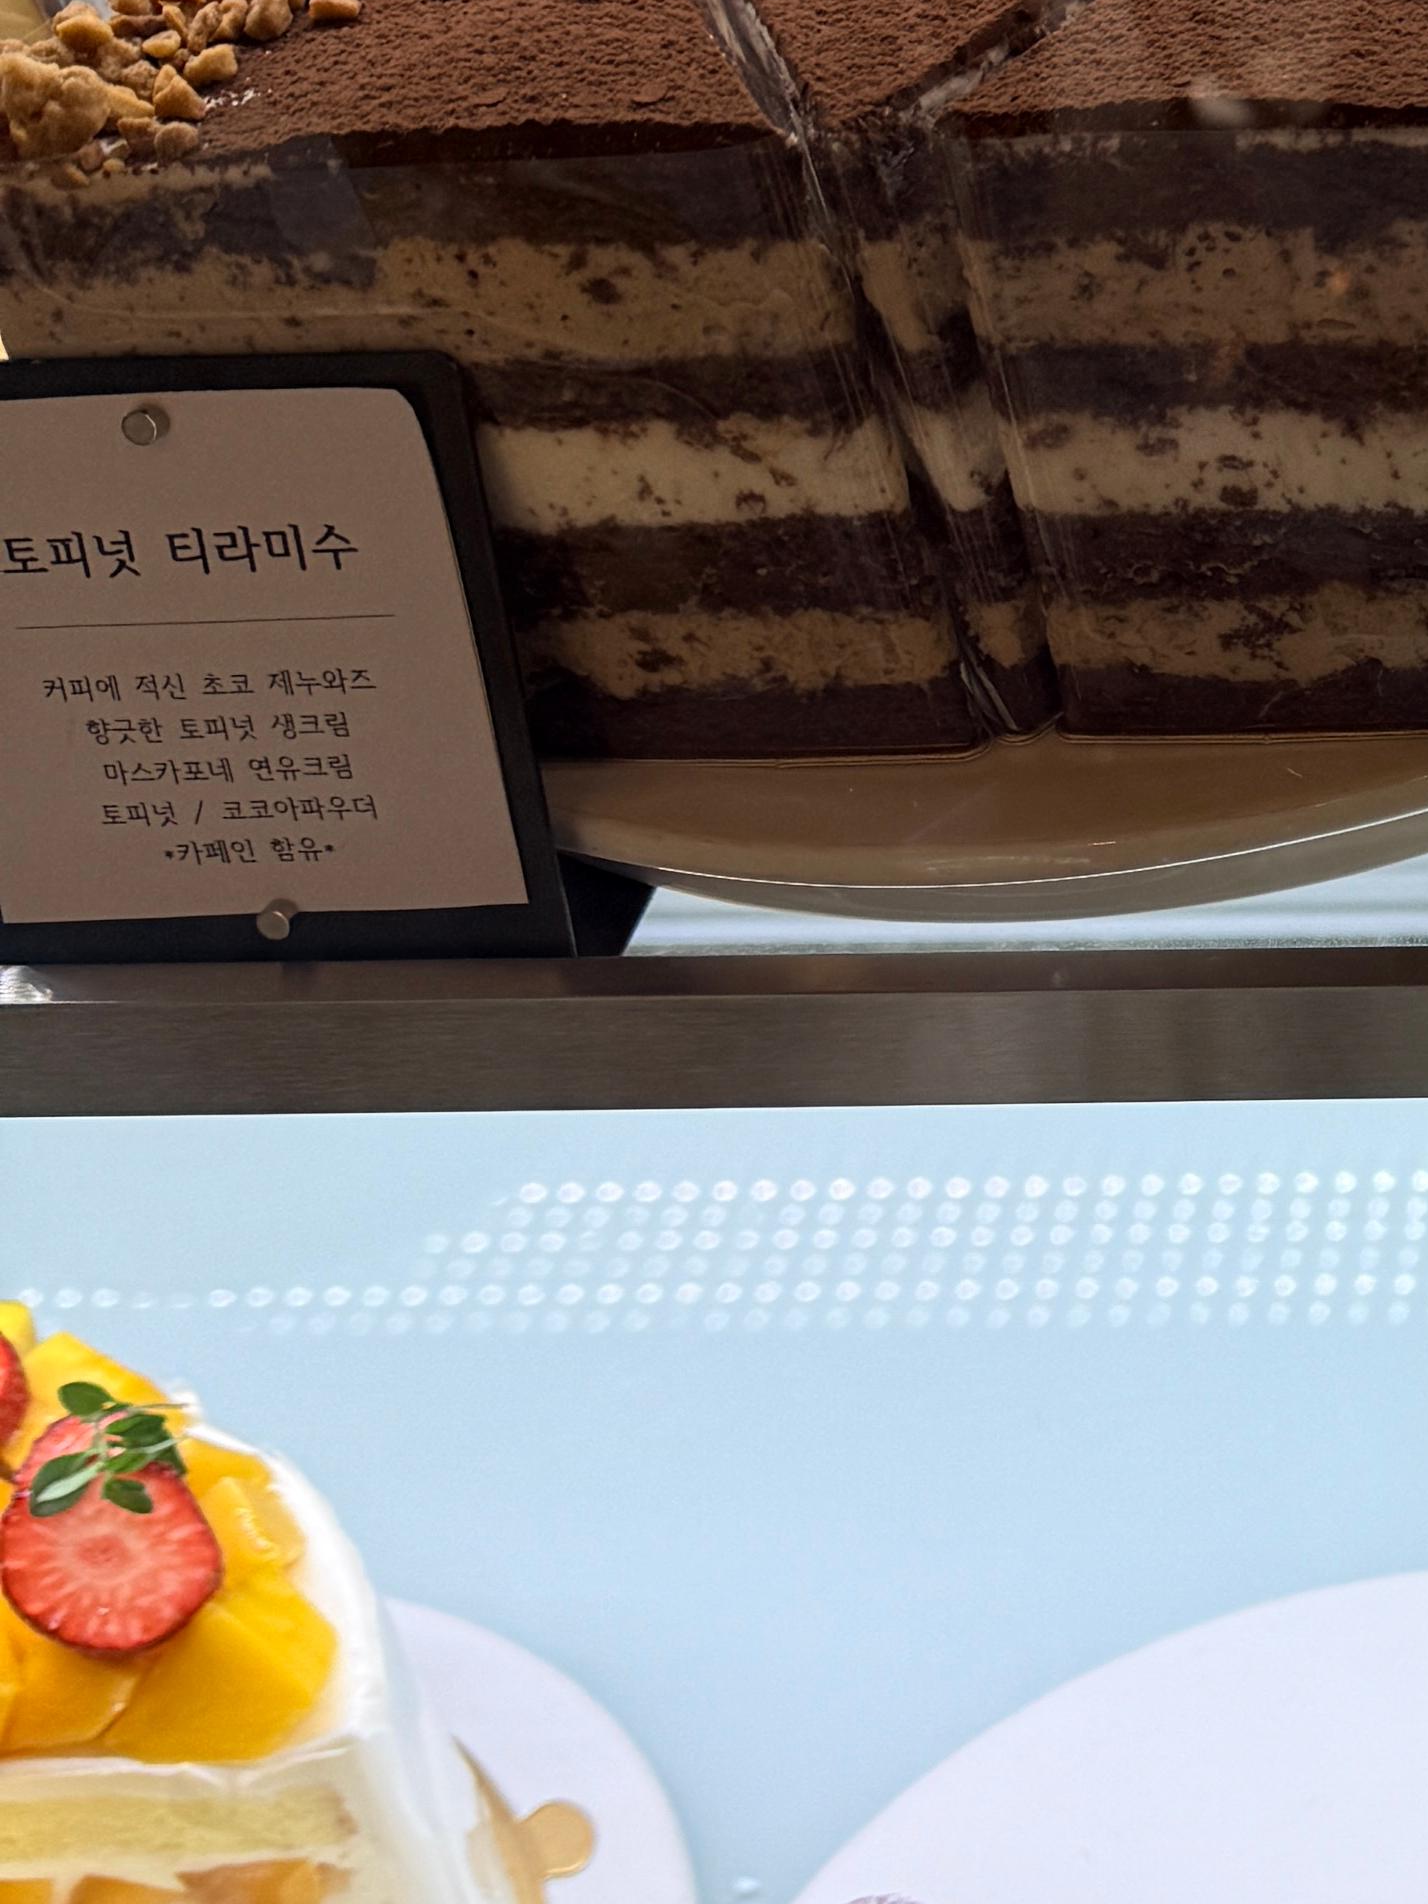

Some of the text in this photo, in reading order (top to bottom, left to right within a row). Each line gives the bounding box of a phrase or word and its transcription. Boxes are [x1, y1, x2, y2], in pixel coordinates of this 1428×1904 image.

[0, 523, 359, 579] 토피넛 티라미수
[42, 667, 377, 703] 커피에 적신 초코 제누와즈
[85, 711, 350, 746] 향긋한 토피넛 생크림
[102, 753, 354, 787] 마스카포네 연유크림
[102, 800, 178, 828] 토피넛
[222, 794, 378, 822] 코코아파우더
